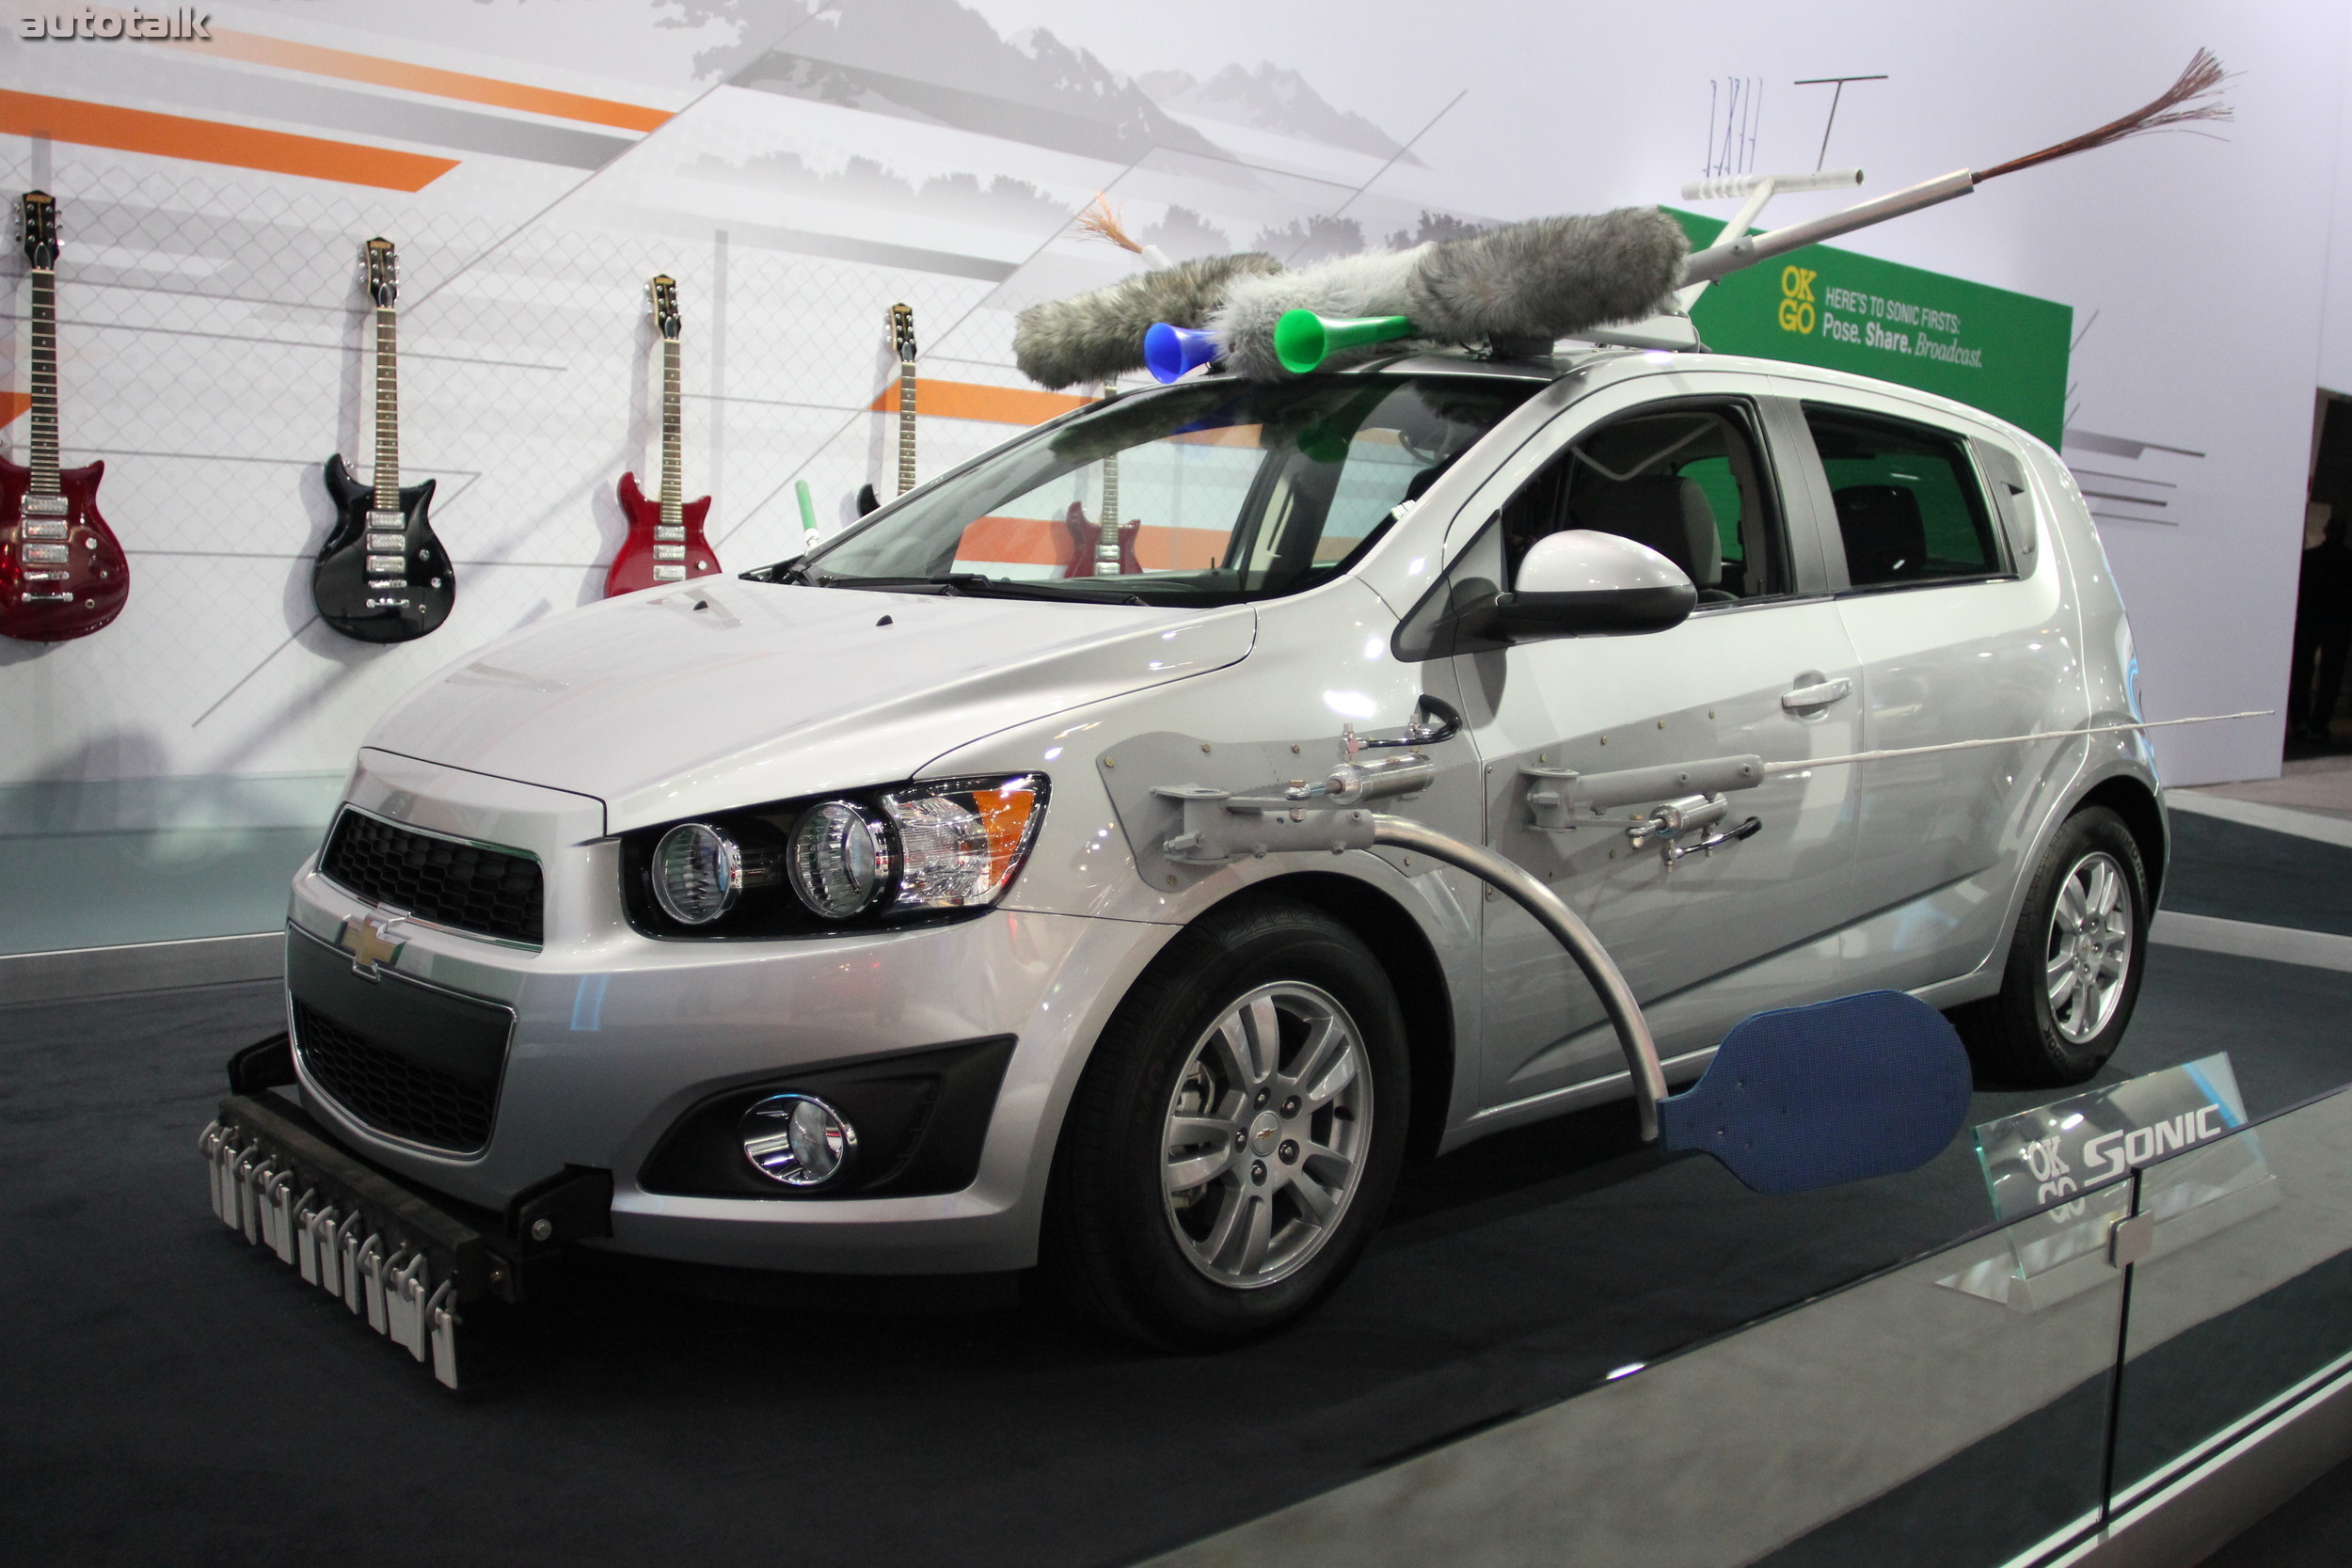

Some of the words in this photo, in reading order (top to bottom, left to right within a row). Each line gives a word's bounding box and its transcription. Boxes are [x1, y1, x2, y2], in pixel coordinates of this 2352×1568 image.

[1782, 265, 1817, 302] OK
[1778, 298, 1816, 334] GO
[1825, 286, 1867, 314] HERE'S
[1869, 295, 1883, 318] TO
[1886, 300, 1920, 326] SONIC
[1921, 308, 1961, 335] FIRSTS:
[1822, 311, 1861, 344] Pose.
[1866, 321, 1912, 355] Share.
[1915, 332, 1982, 368] Broadcast.
[2027, 1135, 2070, 1181] OK
[2083, 1103, 2221, 1187] SONIC
[2038, 1176, 2085, 1223] GO
